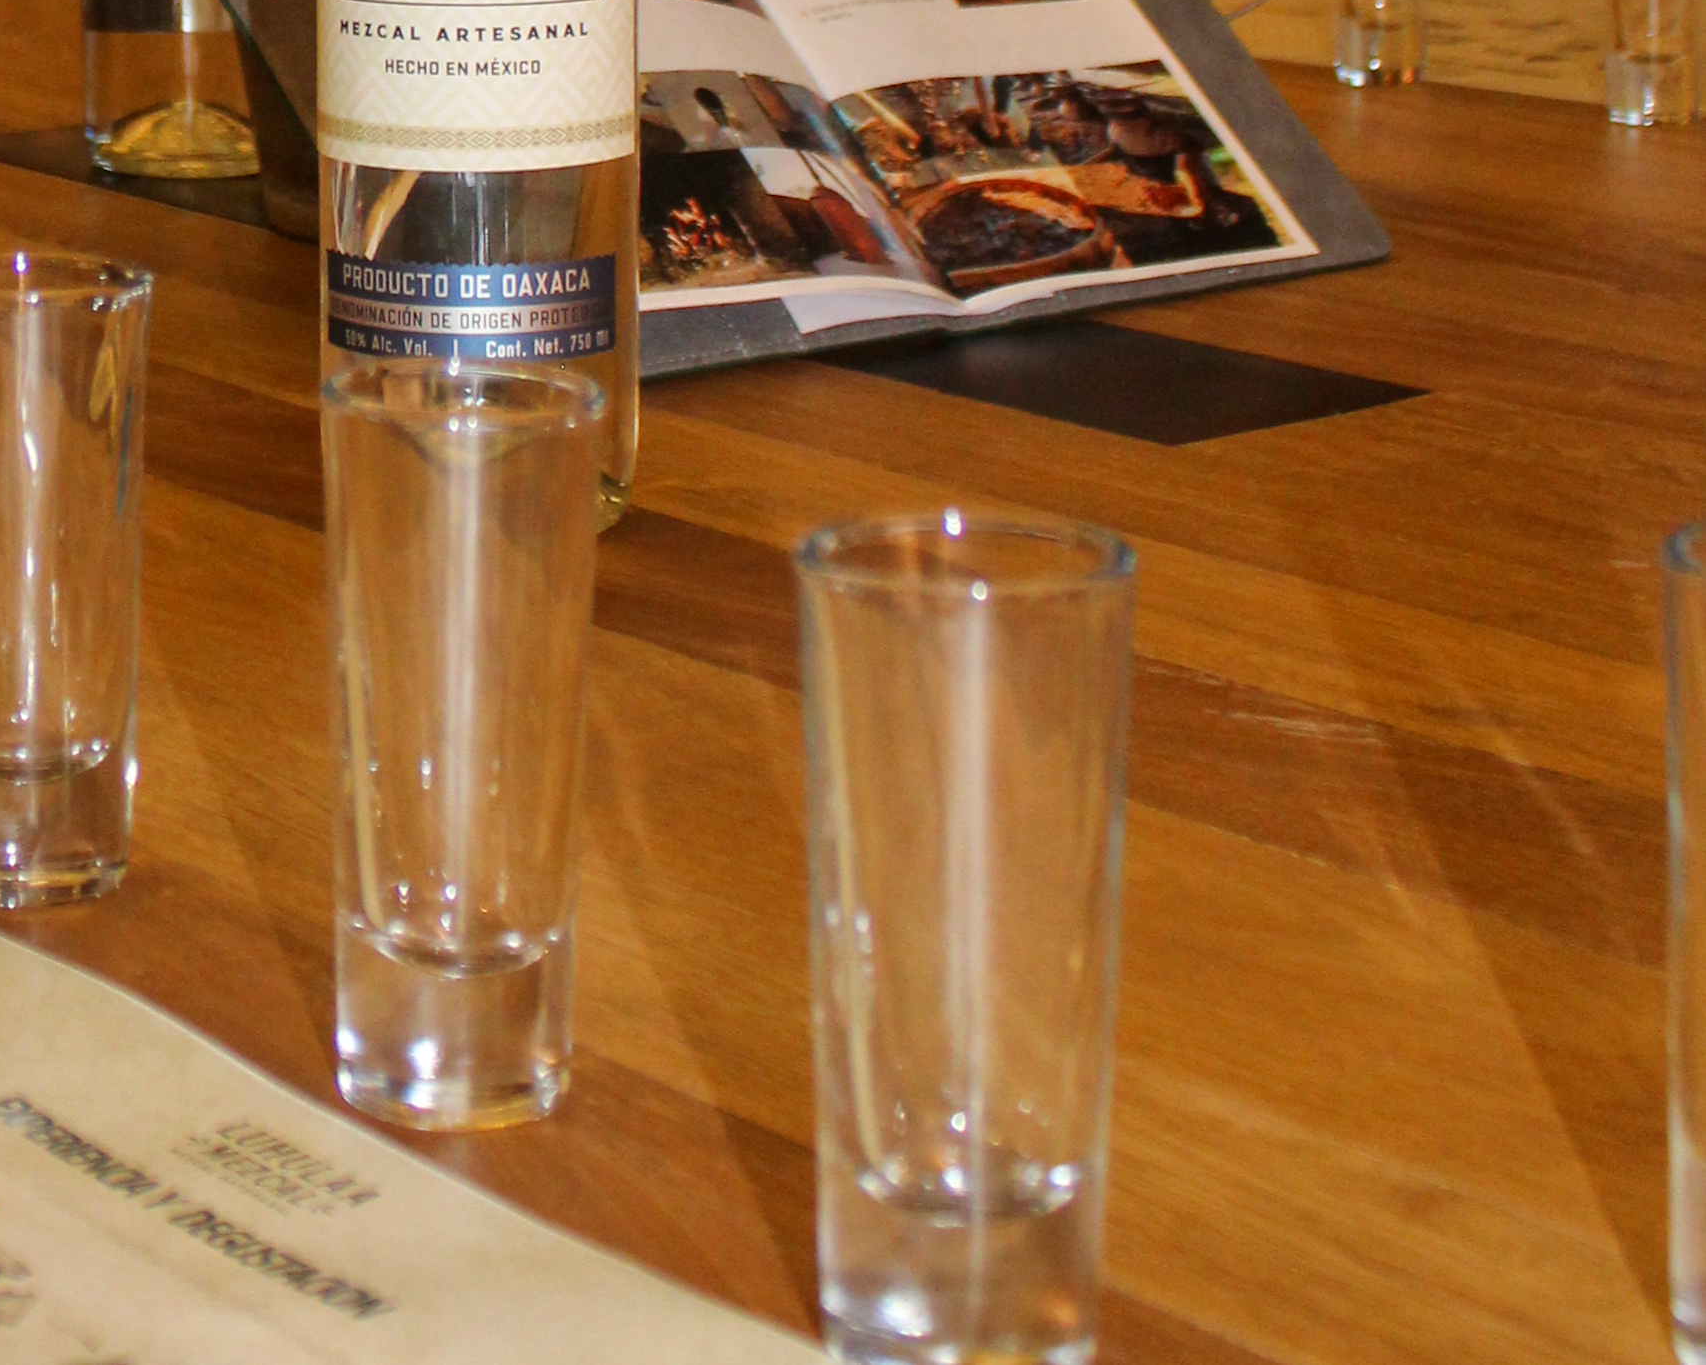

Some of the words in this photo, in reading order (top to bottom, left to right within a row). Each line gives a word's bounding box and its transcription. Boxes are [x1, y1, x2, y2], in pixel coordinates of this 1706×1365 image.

[340, 19, 422, 41] MEZCAL
[435, 21, 590, 43] ARTESANAL
[384, 58, 440, 76] HECHO
[445, 61, 469, 76] EN
[475, 57, 542, 76] MÉXICO
[342, 262, 449, 299] PRODUCTO
[459, 273, 492, 299] DE
[501, 266, 591, 298] OAXACA
[430, 311, 452, 329] DE
[459, 311, 523, 330] ORIGEN
[529, 304, 596, 329] PROTEG
[371, 334, 398, 354] Alc.
[403, 337, 432, 357] Vol.
[485, 339, 527, 359] Cont.
[533, 336, 564, 356] Net.
[570, 332, 592, 352] 750
